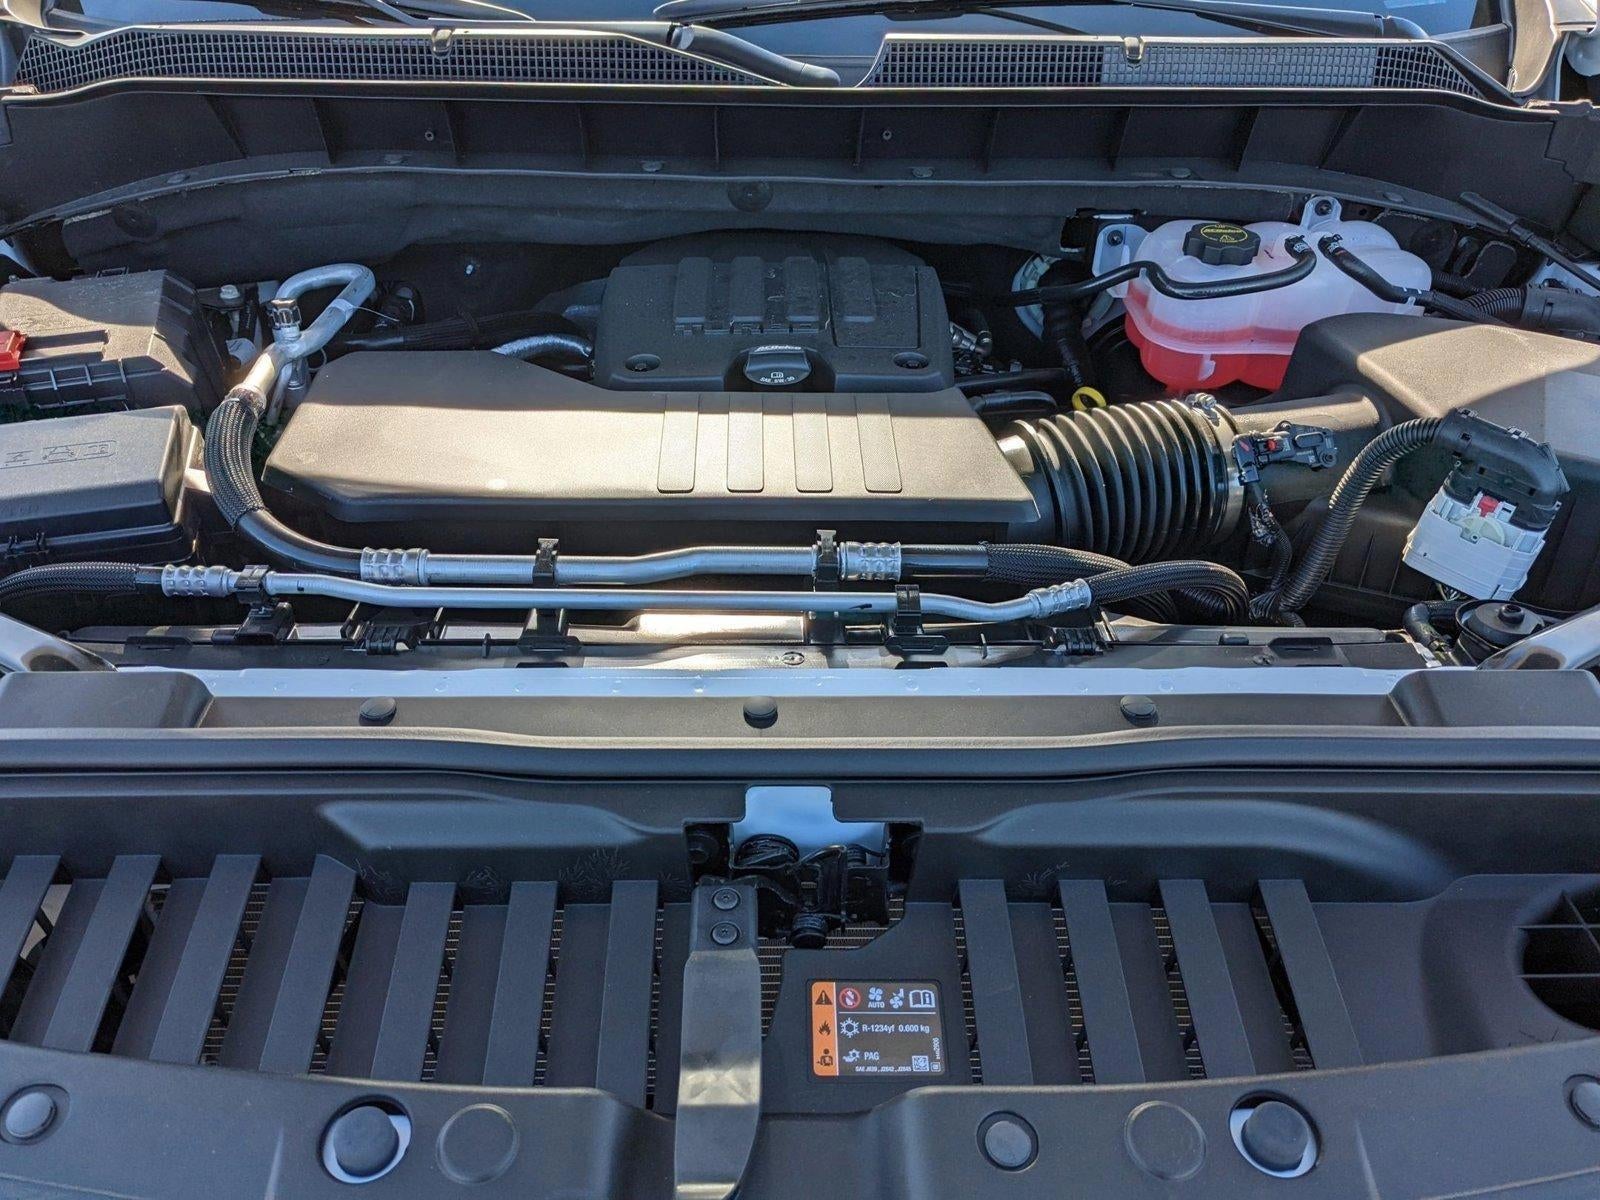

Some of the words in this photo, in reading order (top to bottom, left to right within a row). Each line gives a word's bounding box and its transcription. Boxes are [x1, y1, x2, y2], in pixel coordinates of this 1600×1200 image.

[862, 1025, 895, 1034] R-1234yf
[920, 1025, 930, 1033] kg
[864, 1052, 880, 1060] PAG
